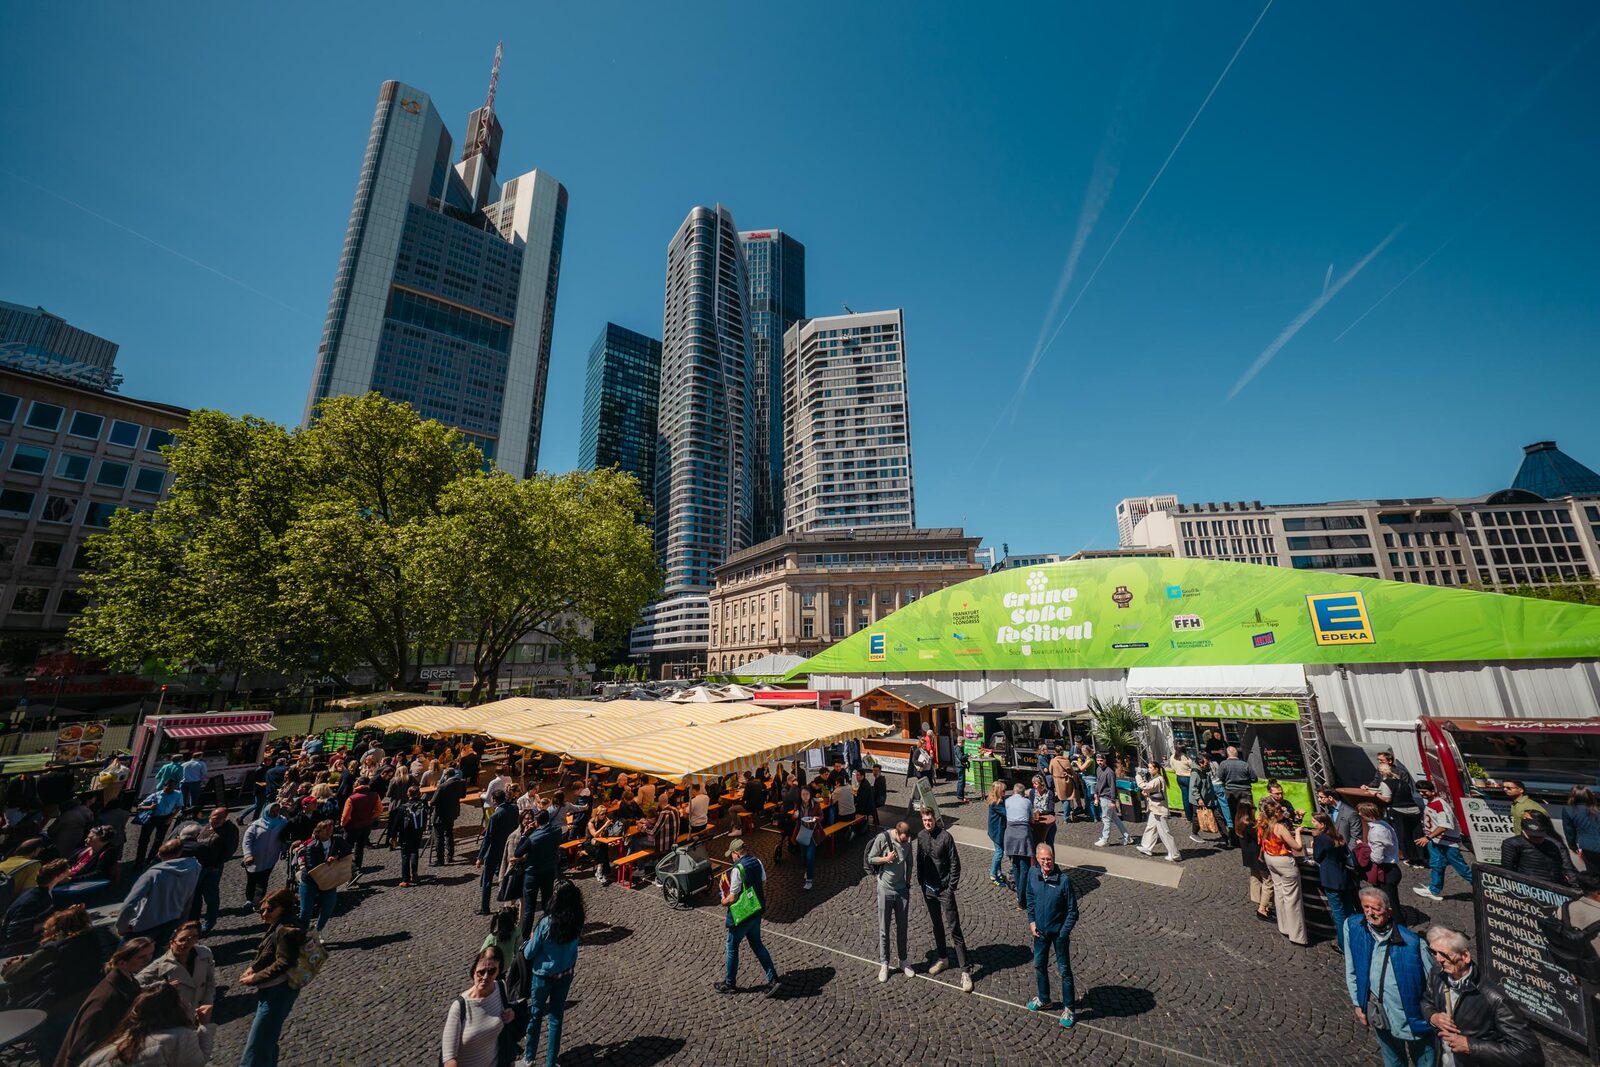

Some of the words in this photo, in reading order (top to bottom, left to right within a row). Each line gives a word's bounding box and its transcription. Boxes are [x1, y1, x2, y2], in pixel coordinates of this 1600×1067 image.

[1174, 618, 1200, 628] FFH
[1321, 632, 1369, 641] EDEKA
[1162, 700, 1273, 718] GETRÄNKE
[1469, 814, 1514, 823] frankf
[1487, 917, 1549, 945] EMPANADAS
[1492, 959, 1523, 980] PAPAS
[1565, 990, 1580, 1004] 5€
